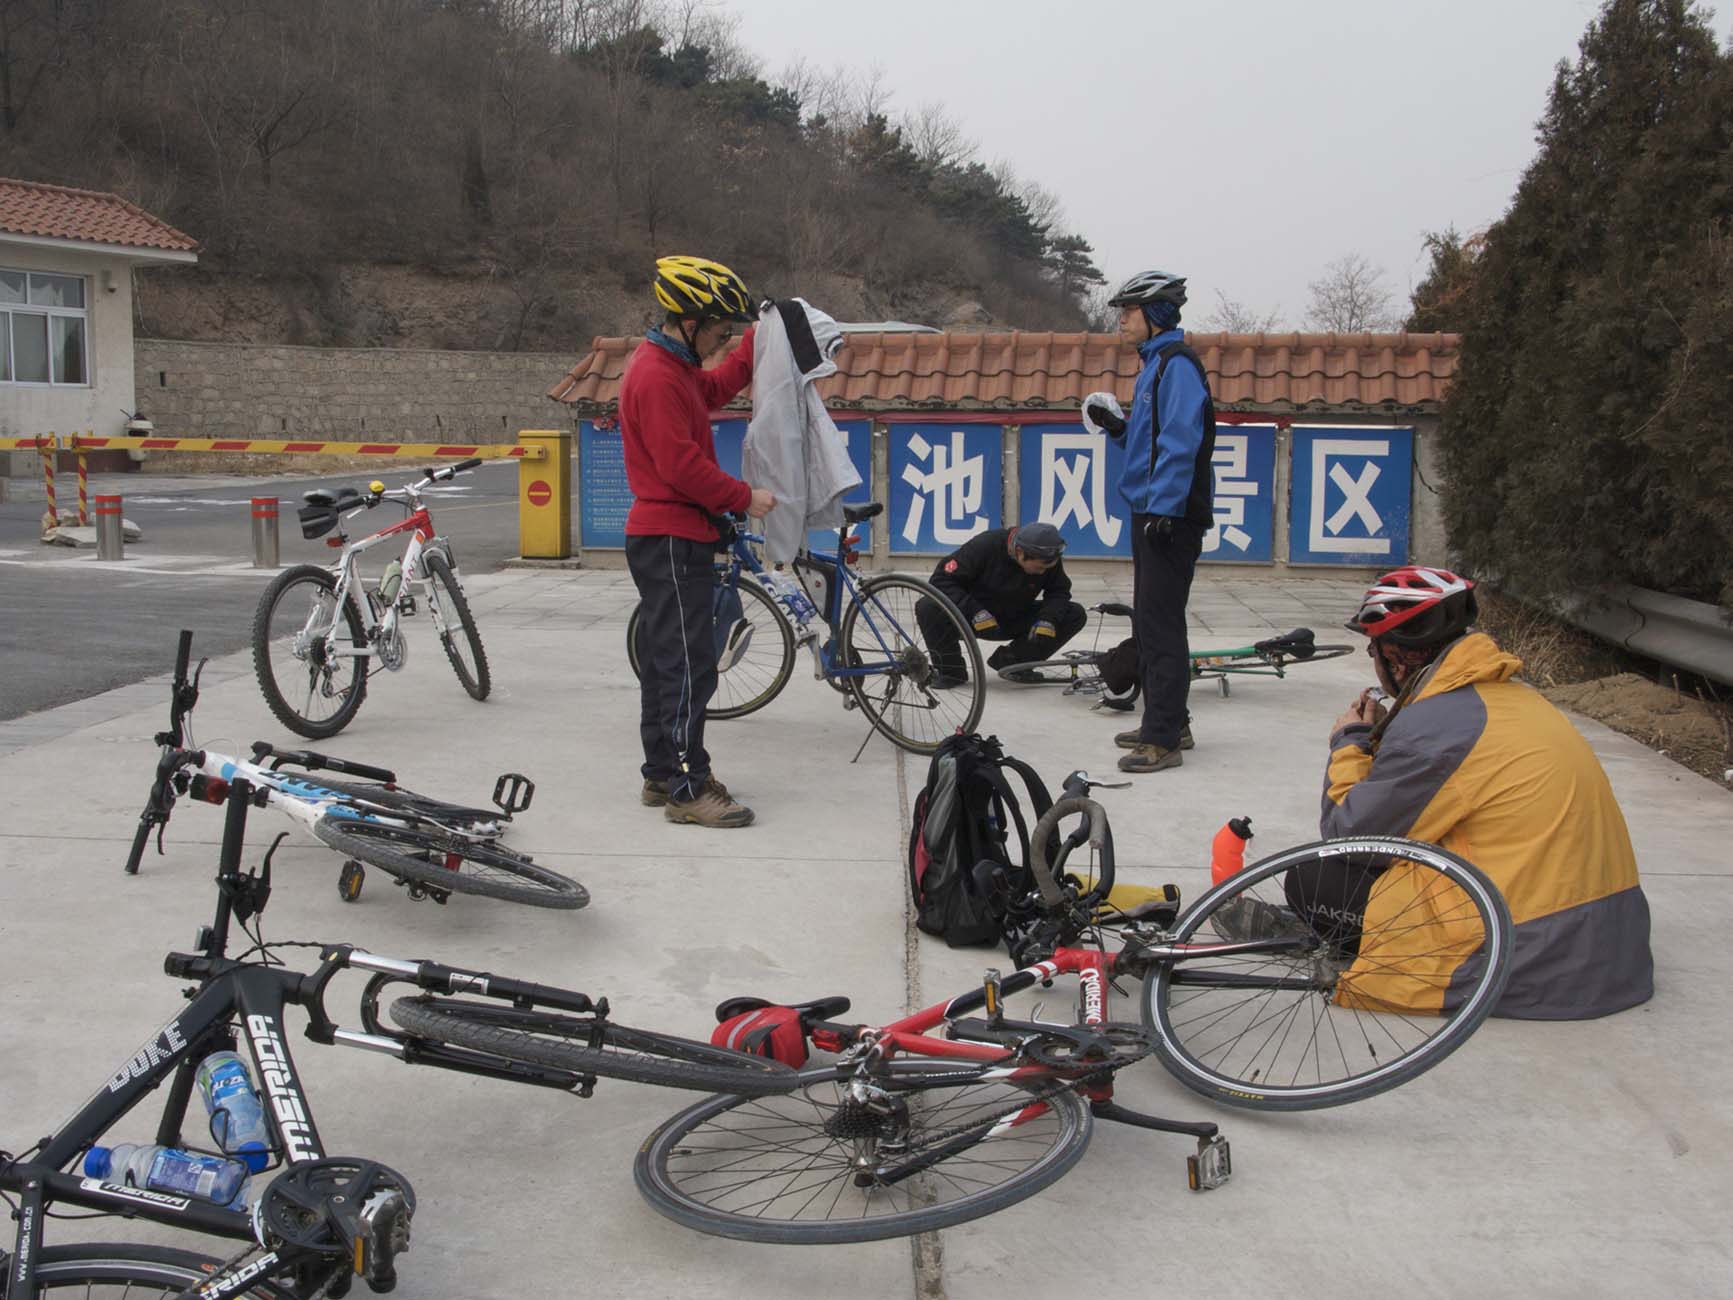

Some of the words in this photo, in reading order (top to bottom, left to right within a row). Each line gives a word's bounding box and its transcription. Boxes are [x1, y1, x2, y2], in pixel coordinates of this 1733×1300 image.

[833, 431, 1391, 554] 池风景区
[1081, 973, 1102, 1017] MERIDA
[109, 1020, 188, 1093] DUKE
[247, 1014, 319, 1163] MERIDA
